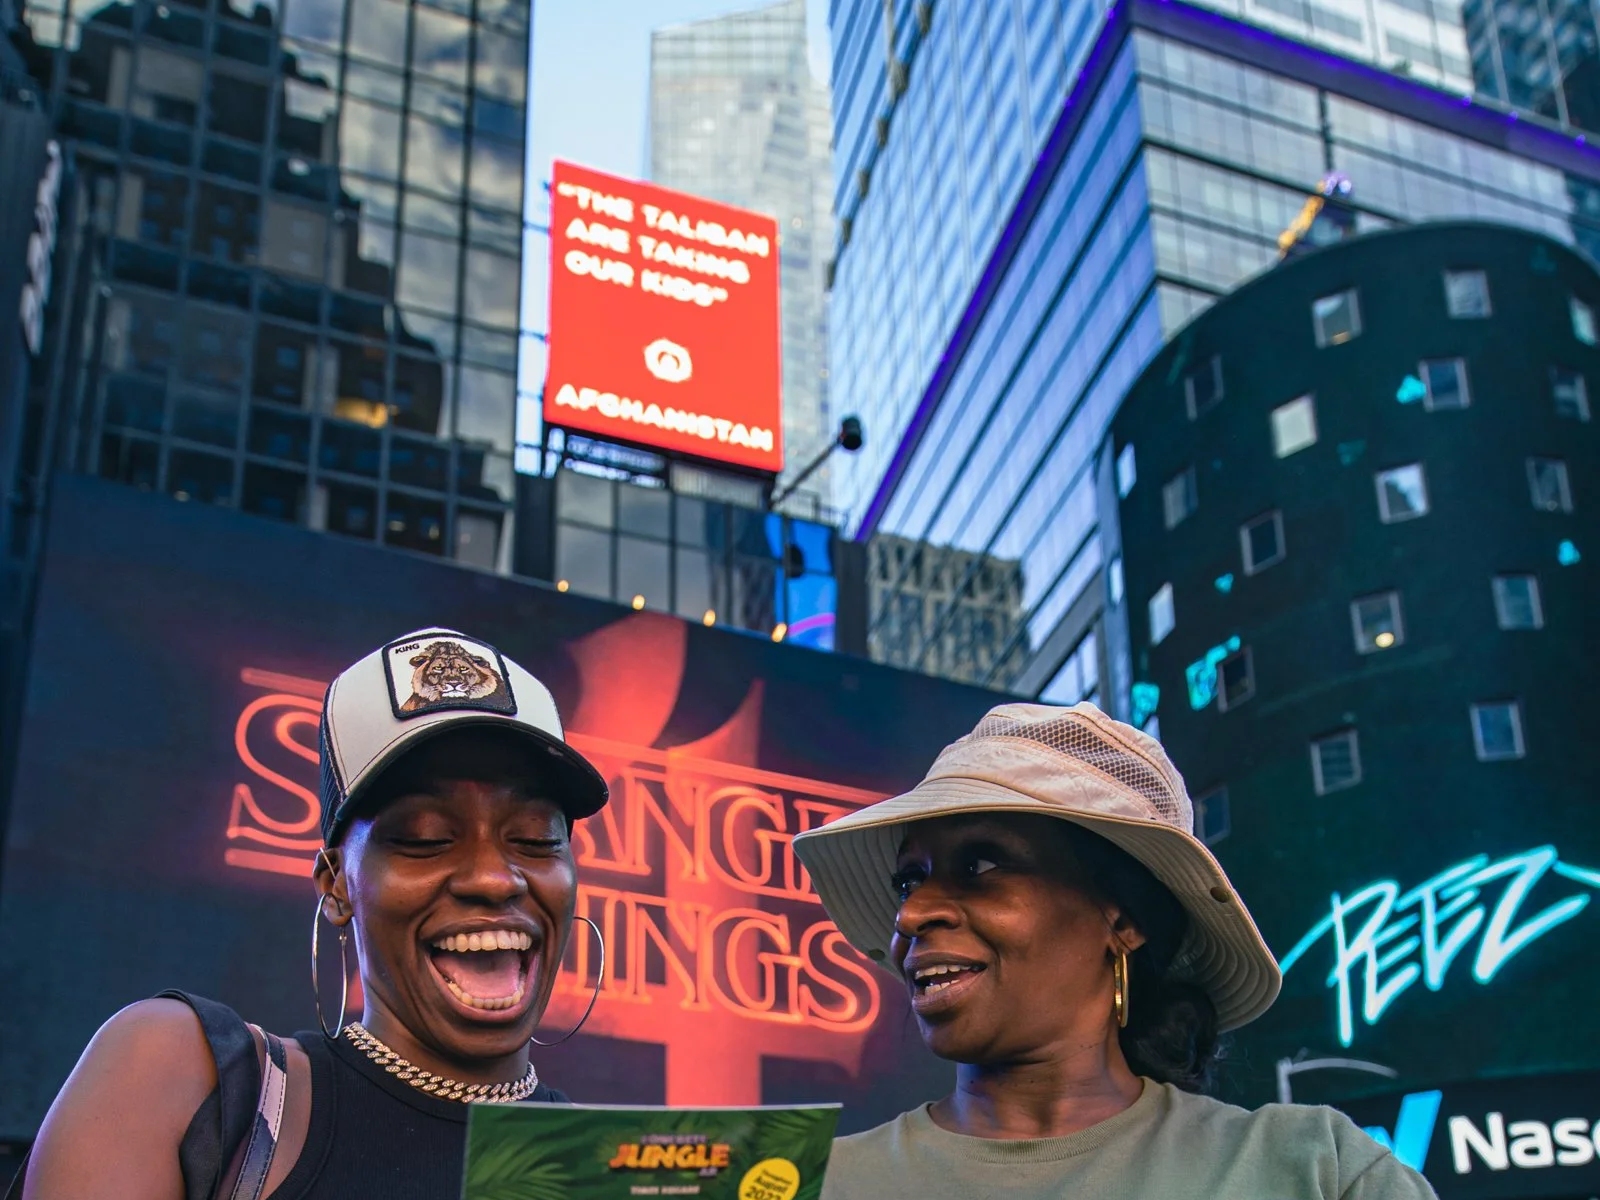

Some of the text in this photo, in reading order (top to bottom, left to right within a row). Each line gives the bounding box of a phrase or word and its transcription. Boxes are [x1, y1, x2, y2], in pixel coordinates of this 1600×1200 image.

[565, 217, 750, 284] ARE TAKING
[640, 204, 770, 257] TALIBAN
[564, 250, 634, 287] OUR
[554, 383, 774, 451] AFGHANISTAN
[394, 642, 420, 654] KING
[562, 880, 880, 1033] INGS
[609, 1143, 730, 1169] JUNGLE
[1448, 1111, 1600, 1175] Nas
